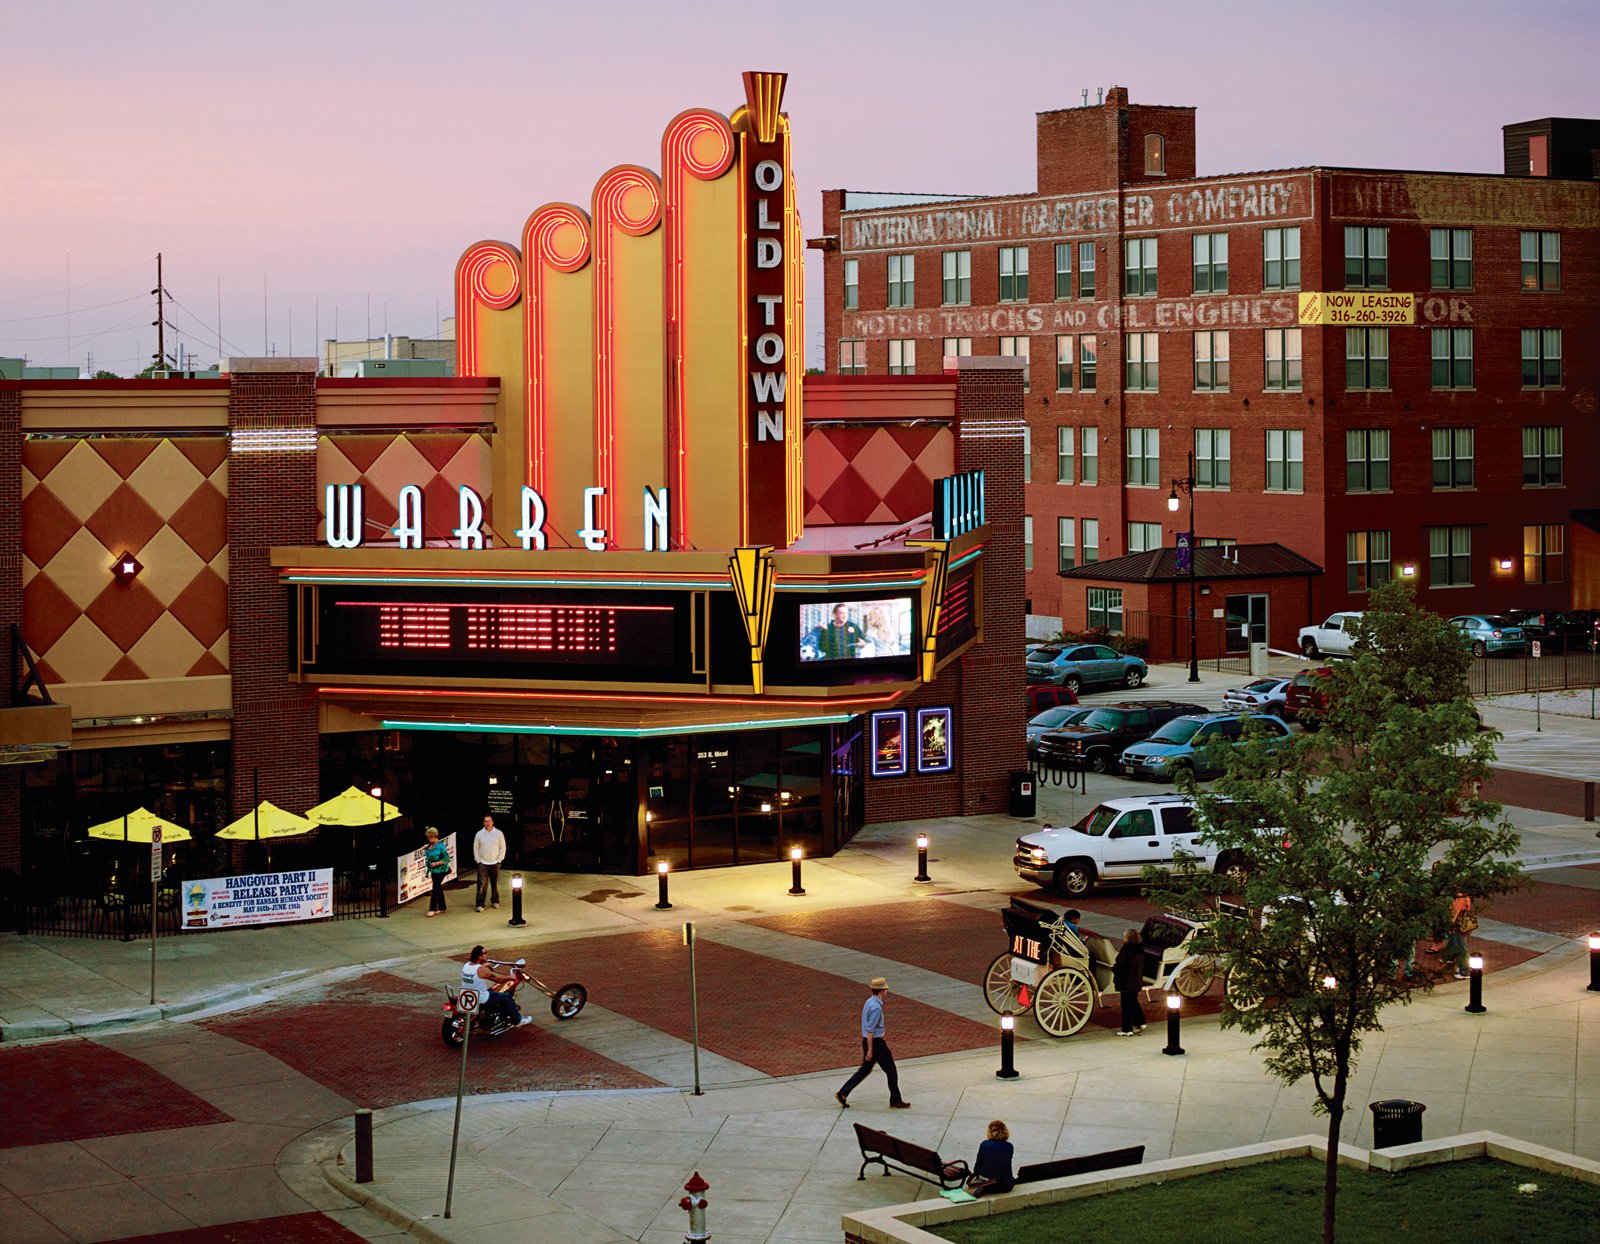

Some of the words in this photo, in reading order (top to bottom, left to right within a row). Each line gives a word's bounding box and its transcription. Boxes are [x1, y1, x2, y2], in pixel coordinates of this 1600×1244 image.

[755, 159, 783, 269] OLD
[1167, 181, 1295, 224] COMPANY
[1326, 295, 1355, 308] NOW
[1362, 295, 1412, 308] LEASING
[853, 313, 932, 335] MOTOR
[940, 308, 1045, 333] TRUCKS
[1053, 308, 1087, 328] AND
[1155, 297, 1296, 327] ENGINES
[1330, 310, 1407, 323] 316-260-3926
[751, 294, 788, 442] TOWN
[326, 484, 670, 551] WARREN
[226, 875, 280, 889] HANGOVER
[282, 871, 306, 884] PART
[308, 871, 316, 882] II
[233, 886, 277, 900] RELEASE
[279, 883, 309, 896] PARTY
[218, 901, 242, 909] BENEFIT
[256, 897, 279, 905] KANSAS
[280, 895, 304, 904] HUMANE
[305, 892, 329, 901] SOCIETY
[1013, 935, 1024, 954] AT
[1026, 938, 1041, 960] THE
